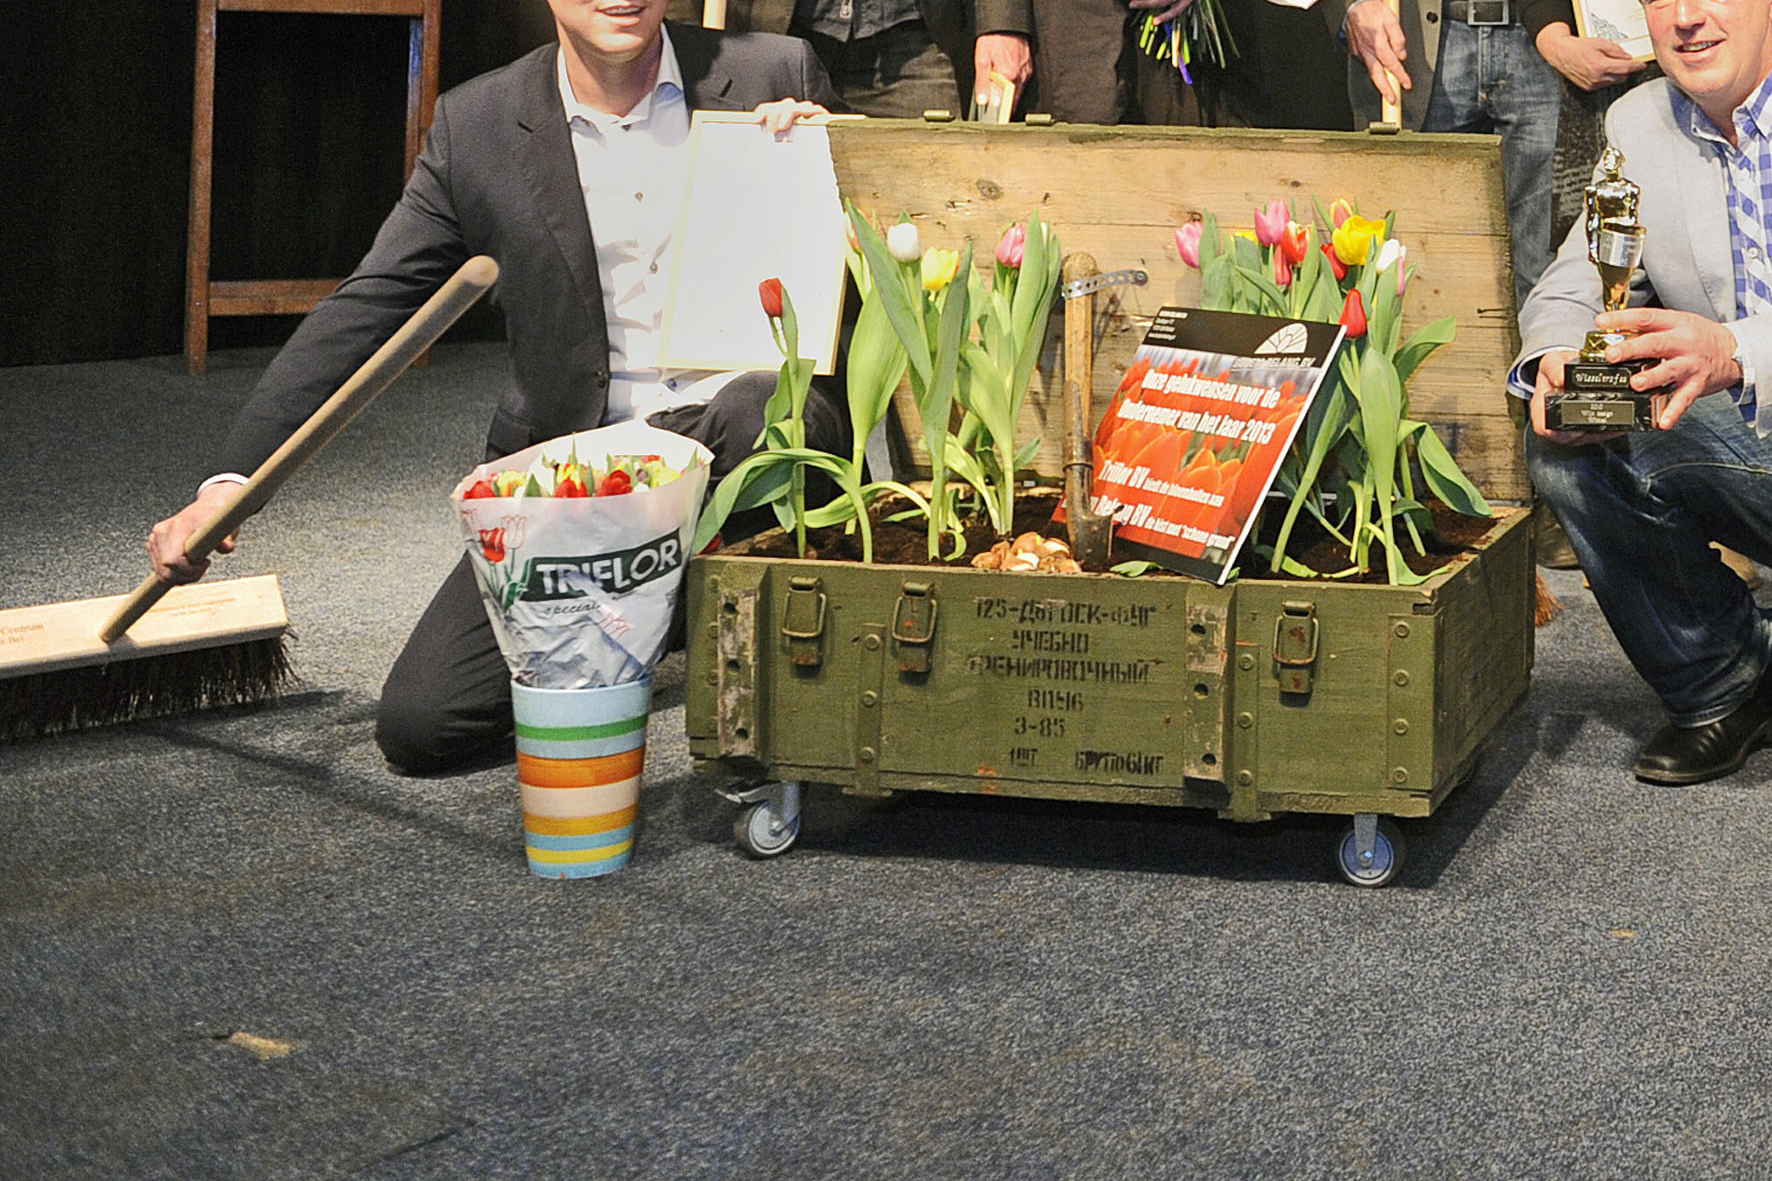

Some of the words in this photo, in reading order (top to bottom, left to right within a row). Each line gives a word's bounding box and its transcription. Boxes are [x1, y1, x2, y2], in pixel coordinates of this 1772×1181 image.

[1141, 368, 1168, 391] Onze
[1163, 373, 1237, 402] gelukwensen
[1234, 385, 1263, 406] voor
[1260, 387, 1281, 409] de
[1117, 398, 1181, 427] Ondernemer
[1177, 411, 1201, 431] van
[1197, 410, 1222, 434] het
[1217, 414, 1247, 439] Jaar
[1241, 420, 1276, 445] 2013
[1128, 465, 1150, 488] BV
[1129, 503, 1153, 528] BV
